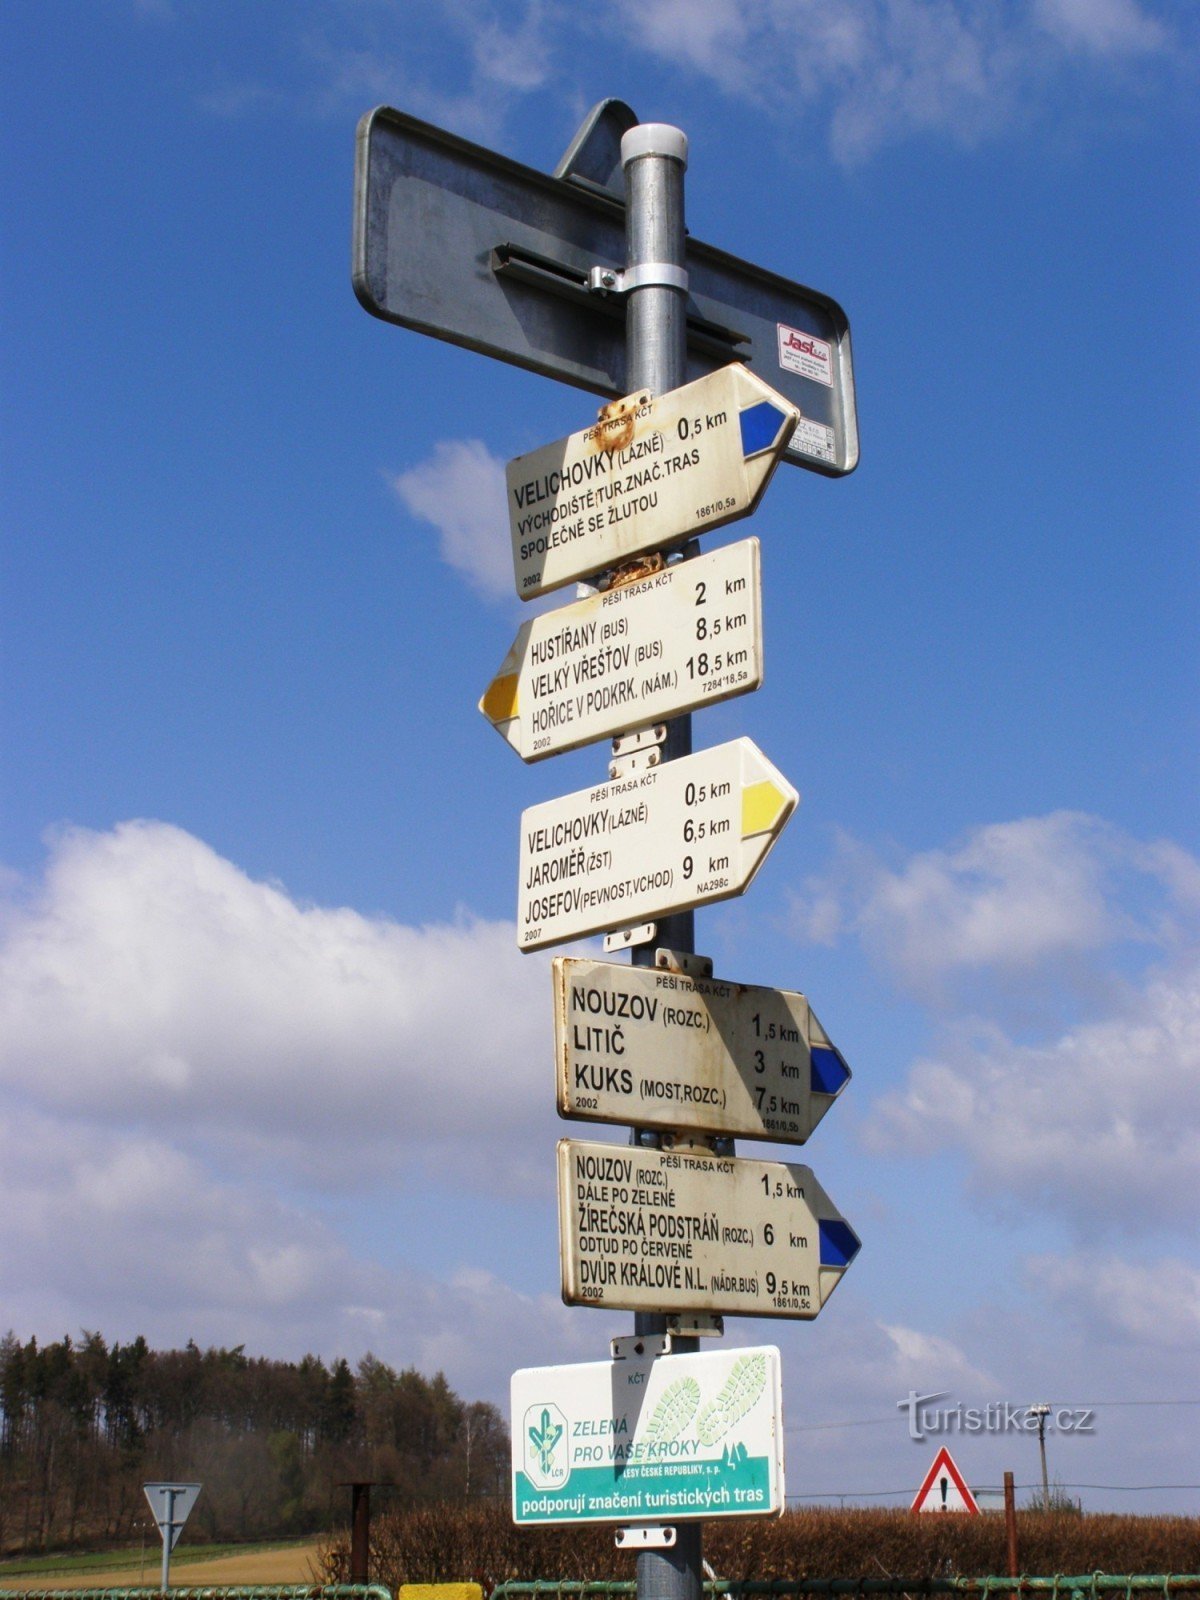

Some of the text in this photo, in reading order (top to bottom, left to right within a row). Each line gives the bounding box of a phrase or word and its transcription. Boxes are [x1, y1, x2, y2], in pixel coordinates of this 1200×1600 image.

[603, 415, 632, 433] TRASA
[635, 404, 653, 420] KČT
[677, 416, 702, 441] 0,5
[706, 410, 727, 430] km
[695, 496, 736, 519] 1861/0,5a
[520, 491, 658, 560] SPOLEČNĚ SE ŽLUTOU
[523, 573, 542, 588] 2002
[602, 572, 674, 607] PĚŠÍ TRASA KČT
[531, 577, 746, 666] HUSTÍŘANY (BUS) 2 km
[531, 613, 747, 699] VELKÝ VŘEŠŤOV (BUS) 8,5 km
[532, 649, 748, 734] HOŘICE V PODKRK. (NÁM.) 18,5 km
[533, 736, 551, 751] 2002
[590, 773, 658, 803] PĚŠÍ TRASA KČT
[684, 782, 706, 807] 0,5
[710, 781, 731, 798] km
[683, 818, 706, 843] 6,5
[709, 819, 730, 836] km
[682, 856, 694, 880] 9
[708, 855, 729, 872] km
[696, 878, 729, 895] NA298c
[524, 928, 542, 942] 2007
[656, 976, 731, 998] PĚŠÍ TRASA KČT
[573, 986, 799, 1044] NOUZOV (ROZC.) 1,5 km
[573, 1023, 799, 1079] LITIČ 3 km
[575, 1063, 800, 1115] KUKS (MOST,ROZC.) 7,5 km
[575, 1097, 598, 1110] 2002
[660, 1155, 735, 1174] PĚŠÍ TRASA KČT
[576, 1155, 805, 1200] NOUZOV (ROZC.) 1,5 km
[577, 1181, 675, 1208] DÁLE PO ZELENÉ
[578, 1203, 808, 1248] ŽÍREČSKÁ PODSTRÁŇ (ROZC.) 6 km
[579, 1237, 693, 1259] ODTUD PO ČERVENÉ
[620, 1258, 682, 1289] KRÁLOVÉ
[684, 1267, 708, 1291] N.L.
[765, 1272, 789, 1298] 9,5
[792, 1280, 811, 1297] km
[581, 1286, 604, 1299] 2002
[772, 1297, 811, 1310] 1861/0,5c
[628, 1371, 646, 1385] KČT
[573, 1413, 628, 1437] ZELENÁ
[574, 1439, 701, 1462] PRO VAŠE KROKY
[640, 1464, 663, 1477] ČESKÉ
[522, 1486, 764, 1516] podporují značení turistických tras
